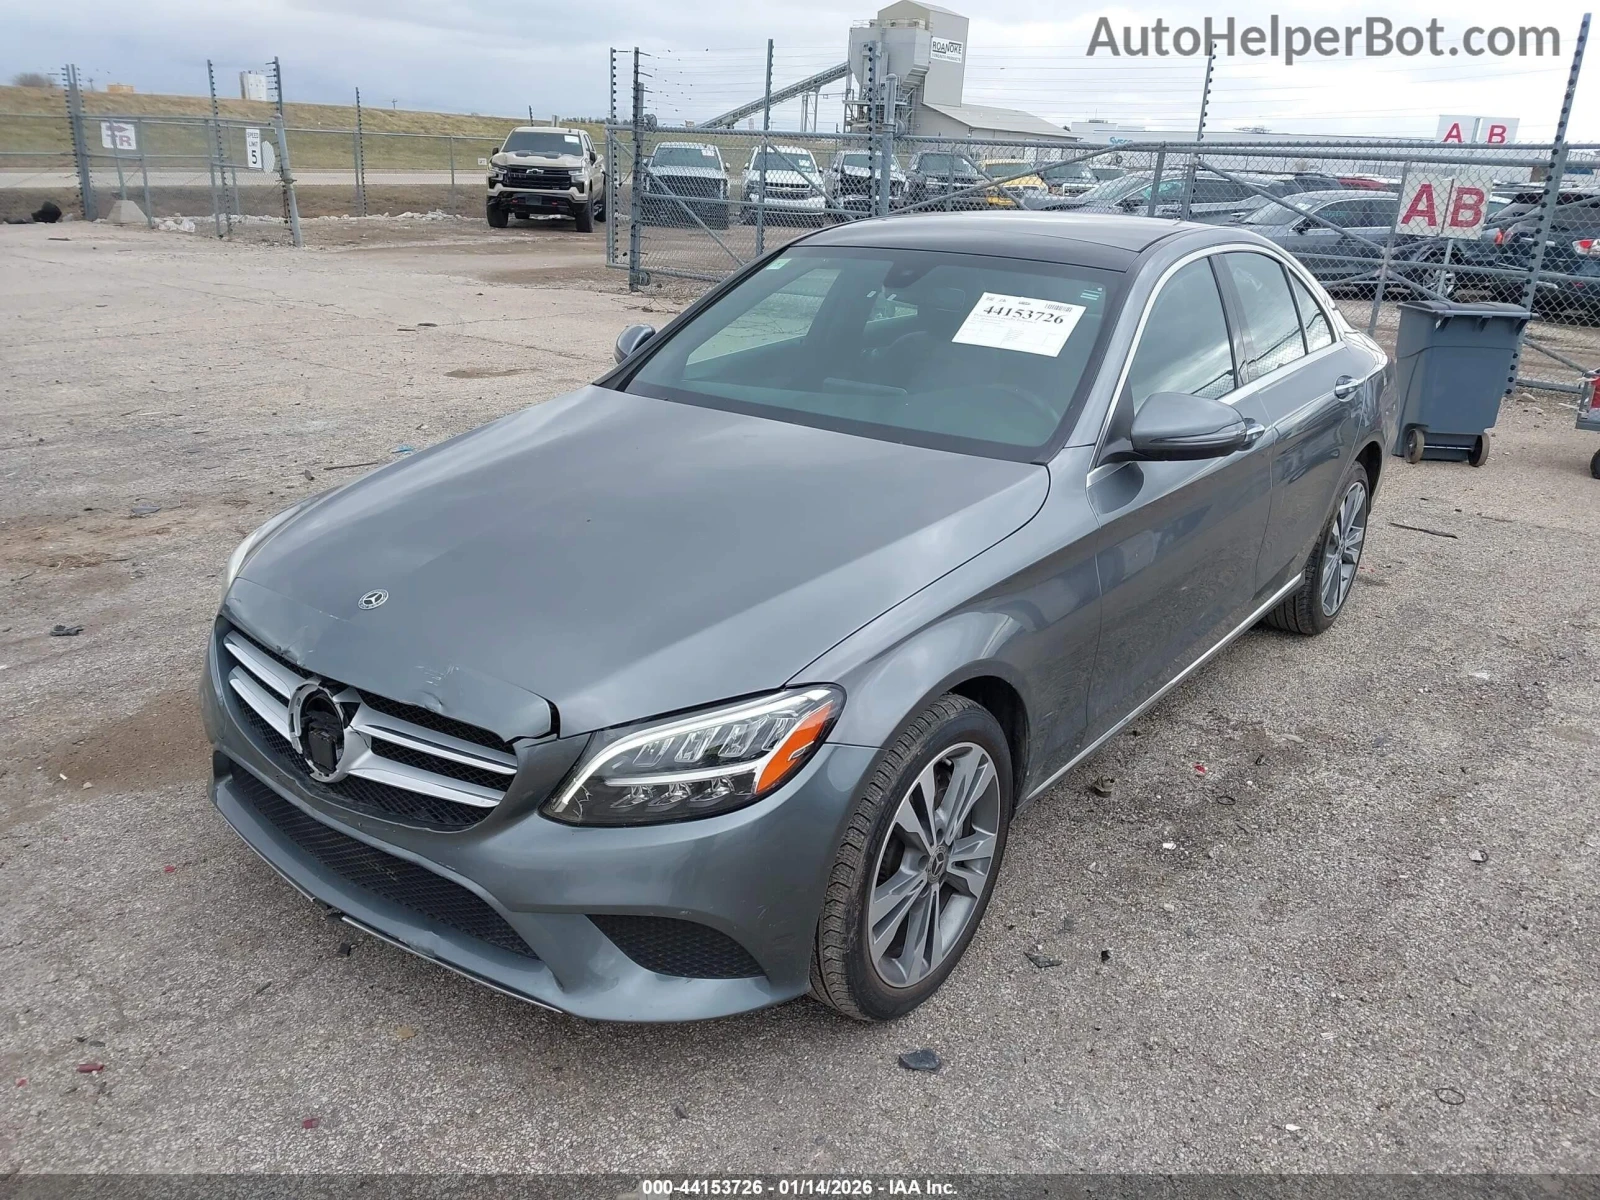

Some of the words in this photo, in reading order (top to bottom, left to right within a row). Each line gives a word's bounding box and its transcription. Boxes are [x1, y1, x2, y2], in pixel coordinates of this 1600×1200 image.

[932, 41, 962, 54] ROANOKE
[1443, 122, 1464, 143] A
[1487, 124, 1507, 144] B
[251, 150, 258, 164] 5
[1400, 183, 1437, 227] A
[1448, 186, 1485, 228] B
[983, 305, 1067, 325] 44153726
